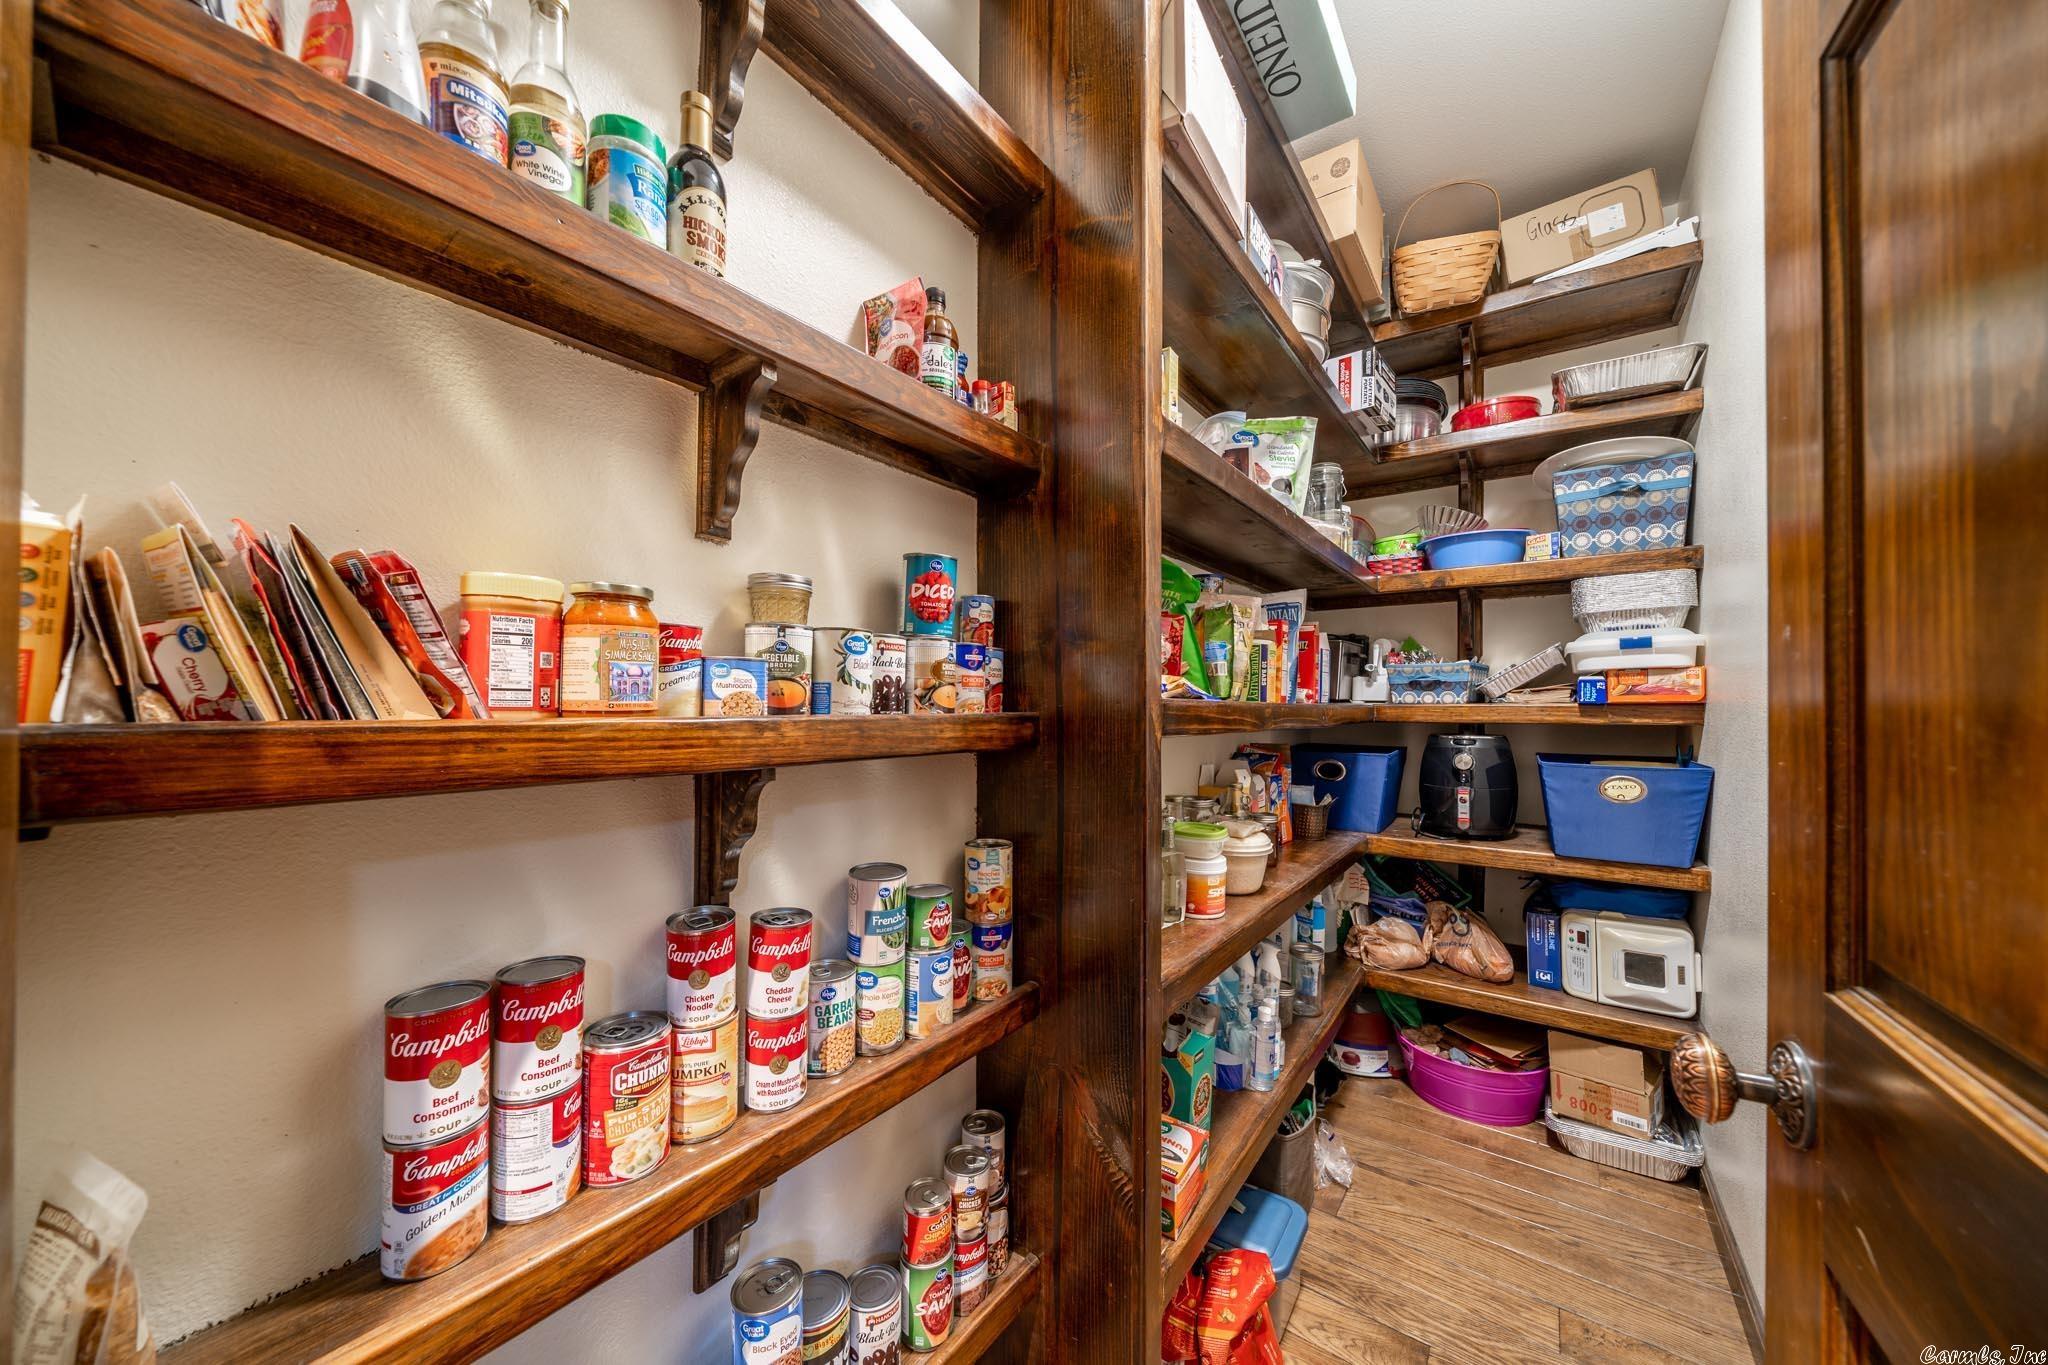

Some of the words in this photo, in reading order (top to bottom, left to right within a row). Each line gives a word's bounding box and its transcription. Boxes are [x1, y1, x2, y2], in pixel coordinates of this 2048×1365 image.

[516, 159, 539, 170] White
[542, 163, 565, 179] Wine
[1526, 213, 1577, 241] Glass
[911, 583, 955, 600] DICED
[492, 616, 518, 624] Nutrition
[518, 616, 534, 624] Facts
[1268, 607, 1298, 622] UNTAIN
[491, 637, 512, 646] Calories
[522, 636, 534, 646] 200
[604, 650, 638, 661] SIMMER
[762, 654, 800, 662] VEGETABLE
[182, 657, 208, 693] Cherry
[660, 664, 681, 672] GREAT
[658, 674, 686, 692] Cream
[716, 682, 753, 690] Mushrooms
[872, 913, 900, 926] French
[766, 986, 794, 995] Cheddar
[684, 993, 715, 1004] Chicken
[767, 995, 792, 1004] Cheese
[686, 1002, 714, 1012] Noodle
[814, 996, 854, 1018] GARBA
[688, 1014, 710, 1023] SOUP
[818, 1008, 854, 1029] BEANS
[682, 1036, 708, 1049] Libby's
[537, 1054, 560, 1069] Beef
[694, 1060, 709, 1069] PURE
[520, 1060, 572, 1082] Consommé
[614, 1056, 668, 1092] CHUNKY
[672, 1060, 727, 1080] UMPKIN
[534, 1079, 562, 1094] SOUP
[756, 1080, 770, 1088] Cream
[777, 1074, 800, 1086] Mushroom
[768, 1086, 788, 1096] Roasted
[432, 1092, 460, 1108] Beef
[768, 1100, 788, 1108] SOUP
[412, 1096, 475, 1124] Consommé
[429, 1120, 462, 1137] SOUP
[608, 1115, 649, 1138] CHICKEN
[408, 1196, 442, 1213] GREAT
[405, 1208, 447, 1242] Golden
[742, 1324, 764, 1334] Great
[752, 1340, 778, 1354] Black
[779, 1325, 798, 1347] Eyed
[780, 1336, 798, 1354] Peas
[856, 1332, 884, 1344] Black
